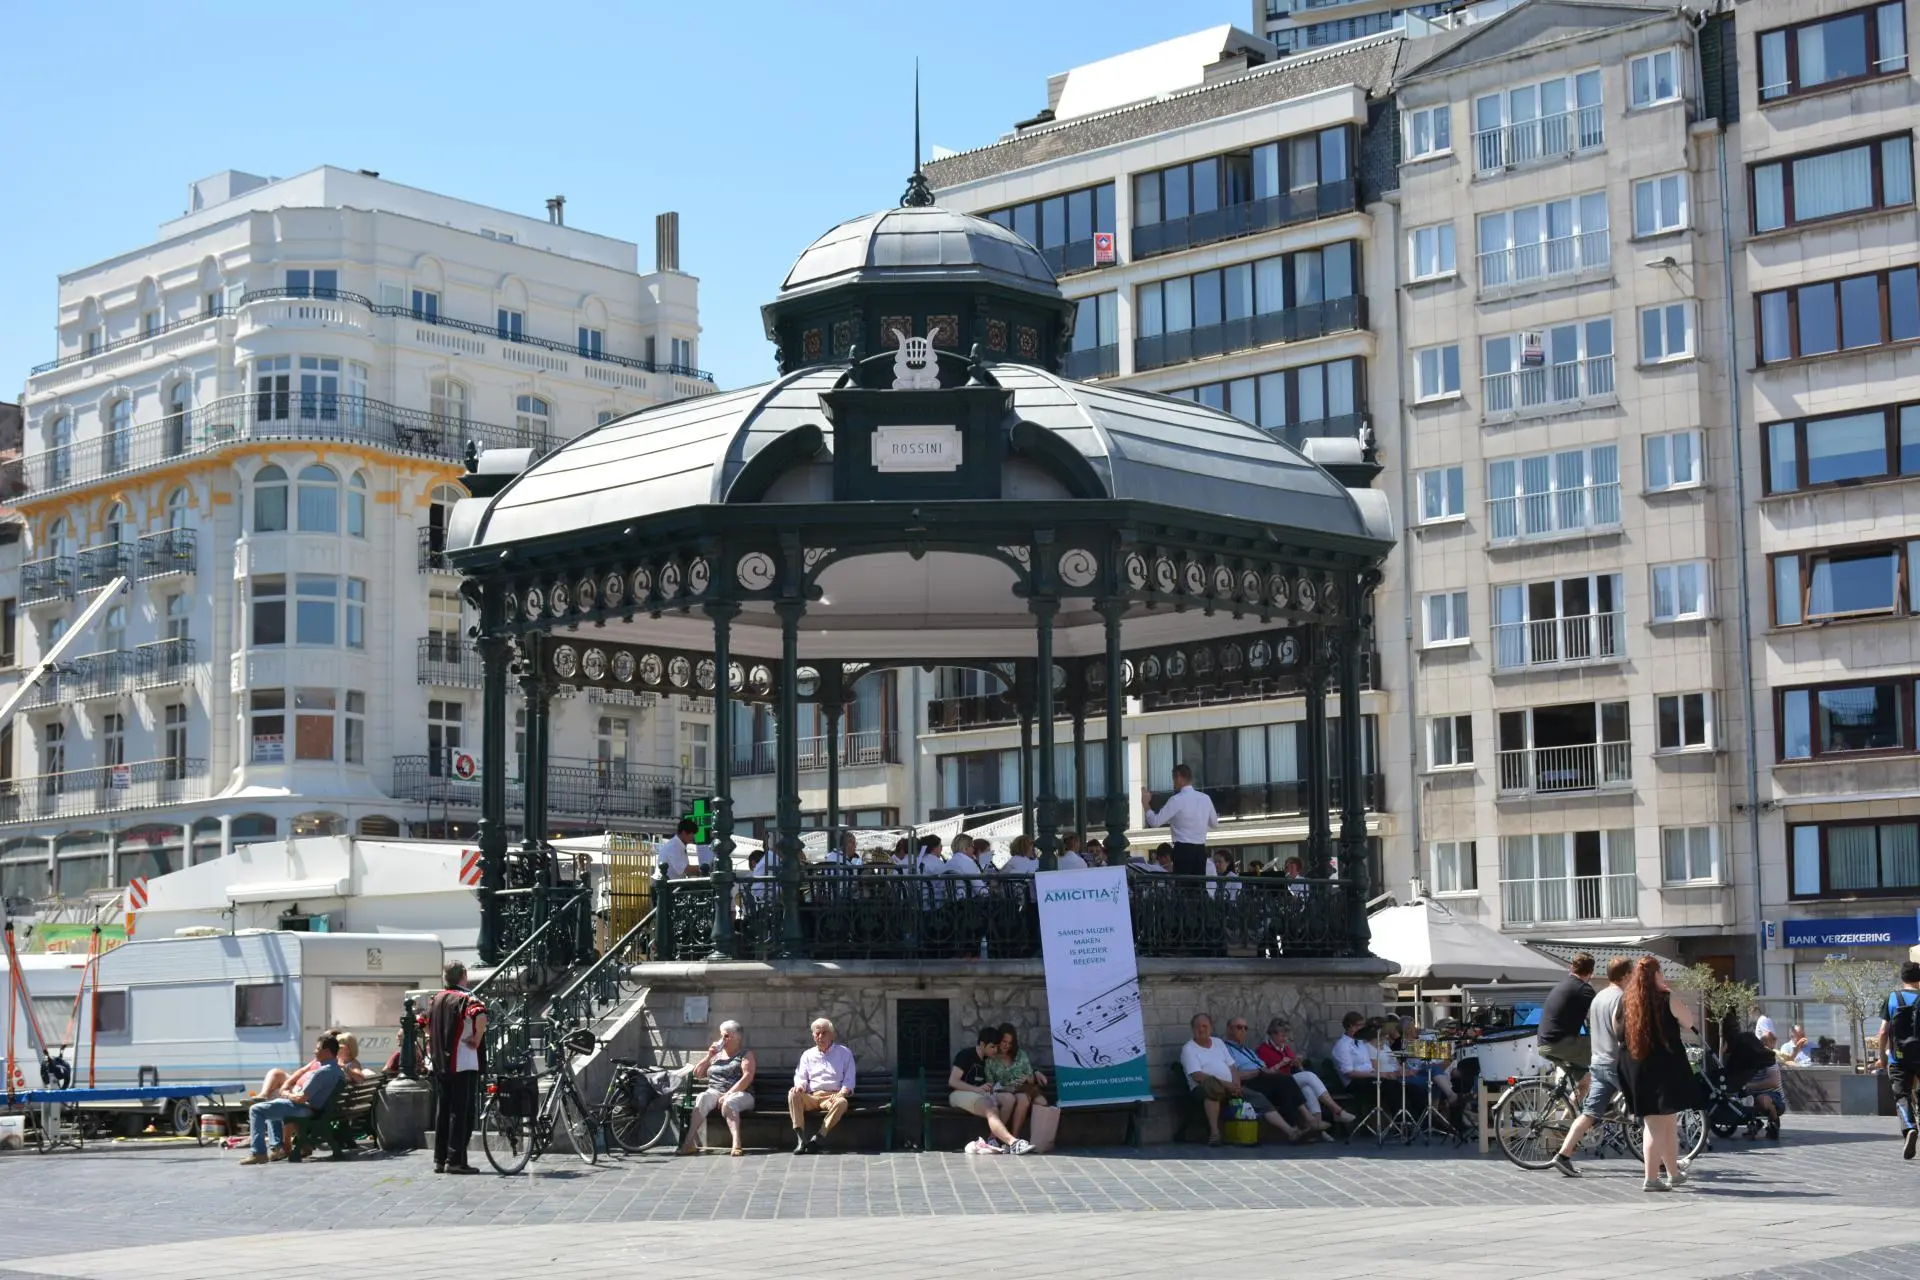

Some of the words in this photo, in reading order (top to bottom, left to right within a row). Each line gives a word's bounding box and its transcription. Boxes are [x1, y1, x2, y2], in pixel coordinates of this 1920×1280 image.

[892, 443, 942, 454] ROSSINI
[1044, 888, 1110, 904] AMICITIA
[1057, 928, 1084, 937] SAMEN
[1086, 926, 1115, 935] MUZIEK
[1073, 937, 1101, 946] MAKEN
[1789, 935, 1817, 944] BANK
[1821, 933, 1891, 943] VERZEKERING
[1078, 946, 1108, 955] PLEZIER
[1072, 957, 1106, 966] BELEVEN
